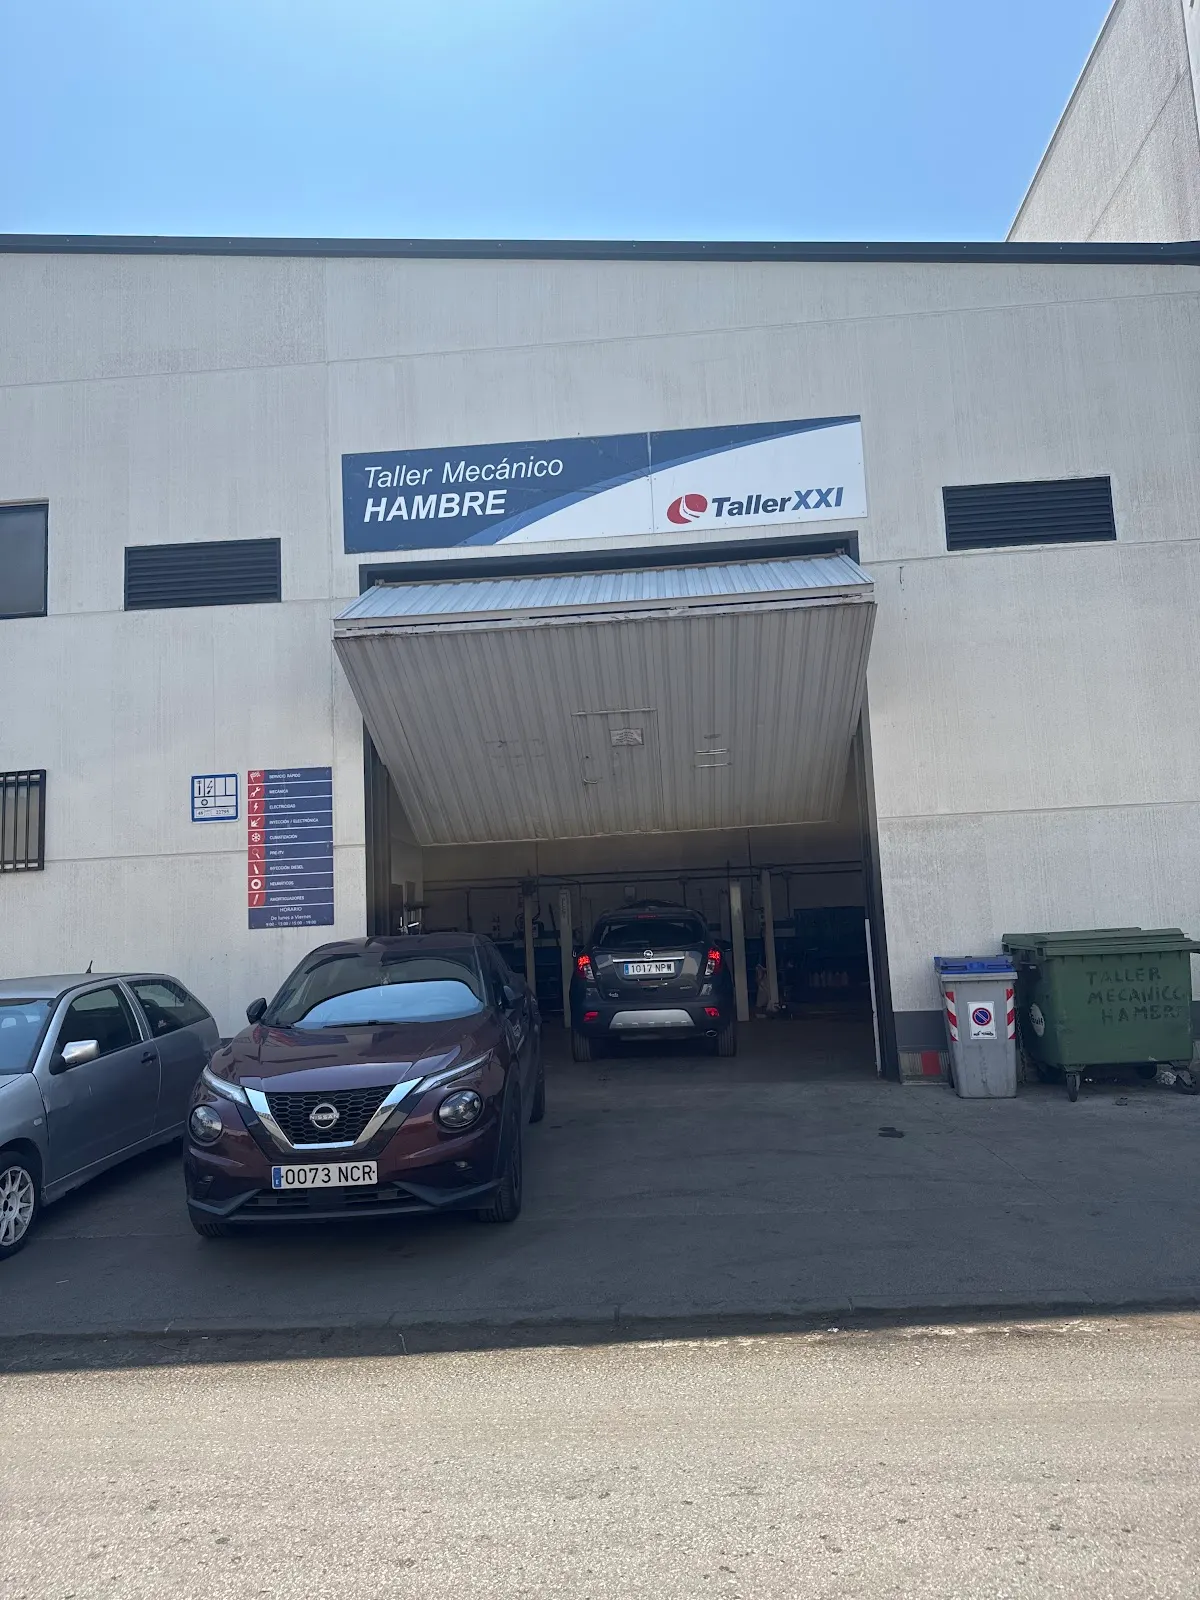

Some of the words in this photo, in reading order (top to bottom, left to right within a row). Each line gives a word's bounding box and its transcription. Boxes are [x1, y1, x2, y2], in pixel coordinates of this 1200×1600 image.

[364, 464, 433, 489] Taller
[442, 456, 564, 484] Mecánico
[363, 489, 507, 523] HAMBRE
[711, 486, 844, 518] TallerXXI
[631, 965, 653, 974] 1017
[655, 963, 672, 972] NPW
[1085, 967, 1161, 985] TALLER
[310, 1112, 340, 1121] NISSAN
[284, 1168, 331, 1185] 0073
[338, 1164, 374, 1182] NCR
